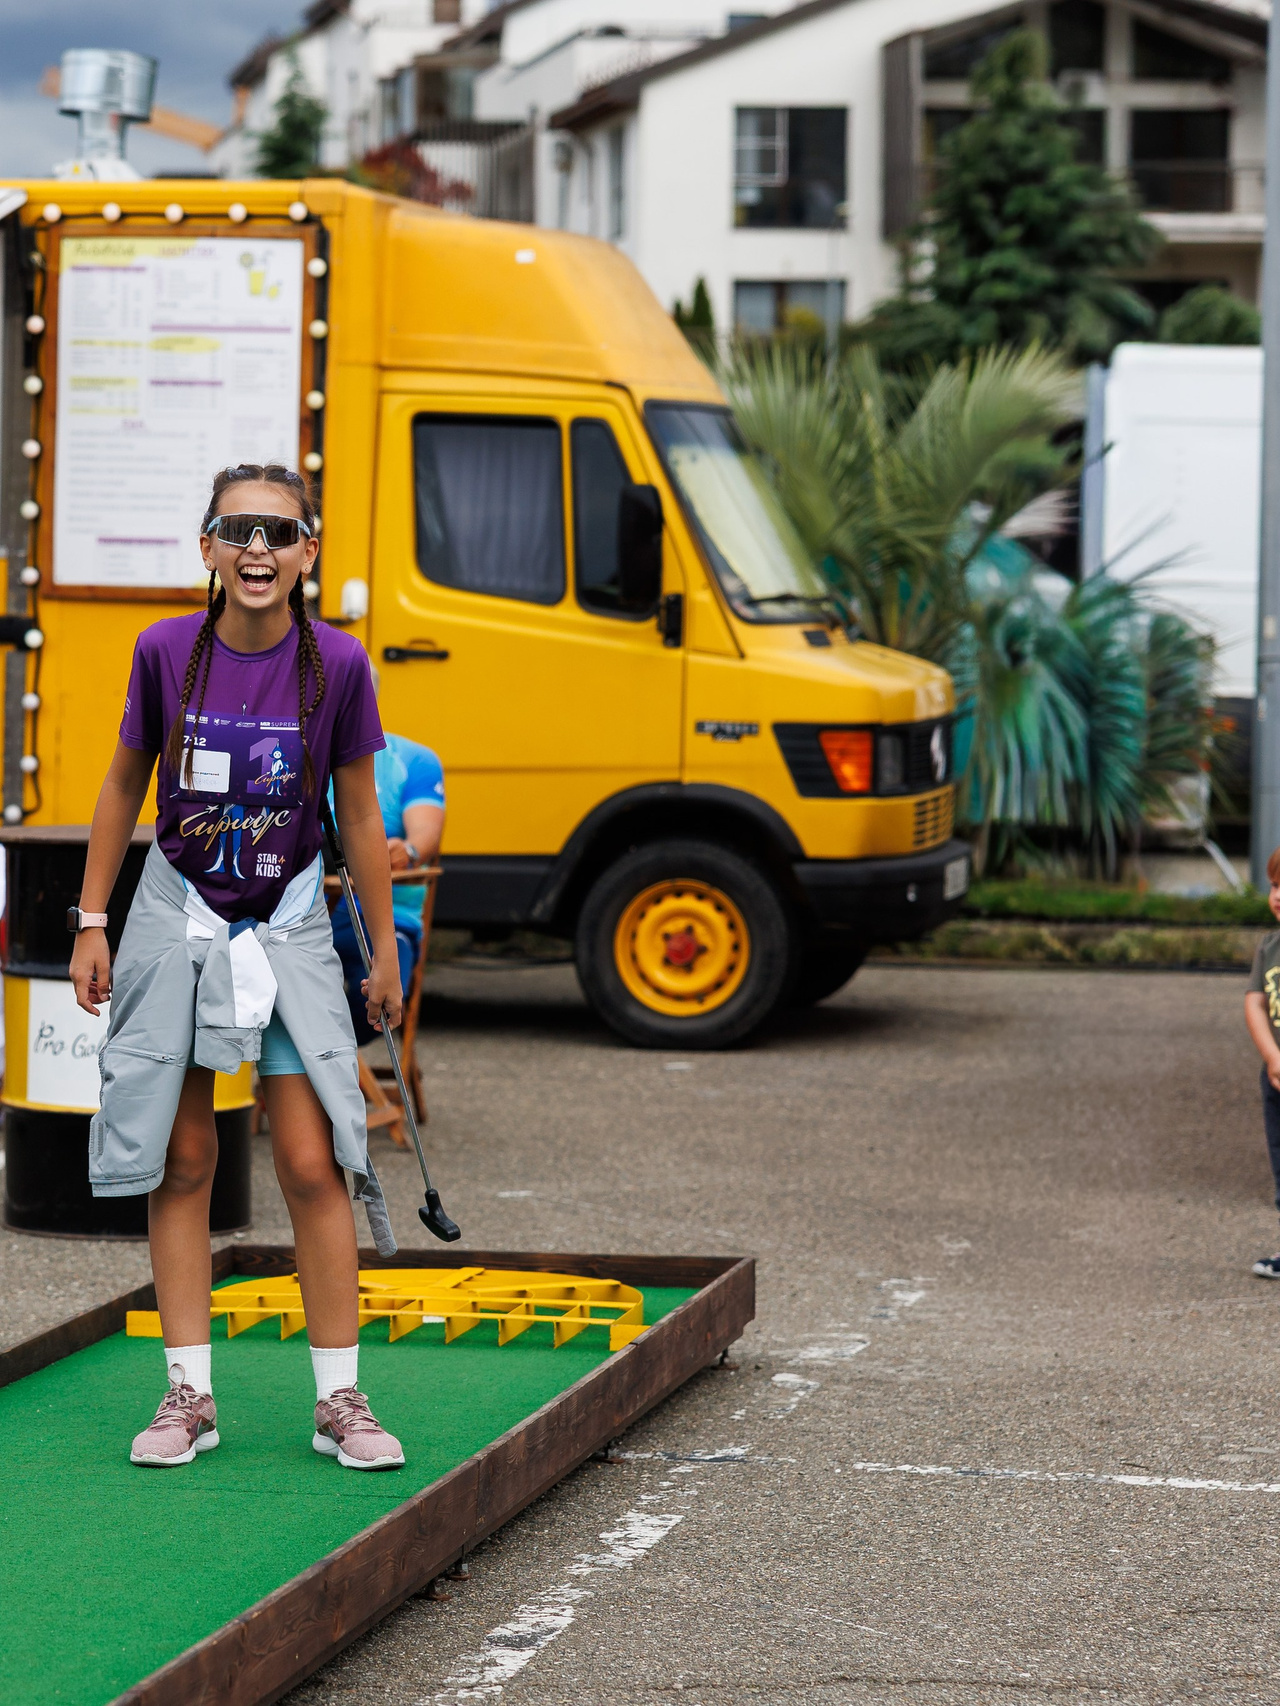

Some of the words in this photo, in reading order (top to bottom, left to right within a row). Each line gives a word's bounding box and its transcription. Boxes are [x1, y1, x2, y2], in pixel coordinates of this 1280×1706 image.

[183, 735, 207, 746] 7-12
[180, 808, 292, 852] Сириус
[257, 853, 278, 864] STAR
[255, 864, 282, 878] KIDS
[33, 1020, 65, 1056] Pro
[71, 1032, 108, 1059] Gol
